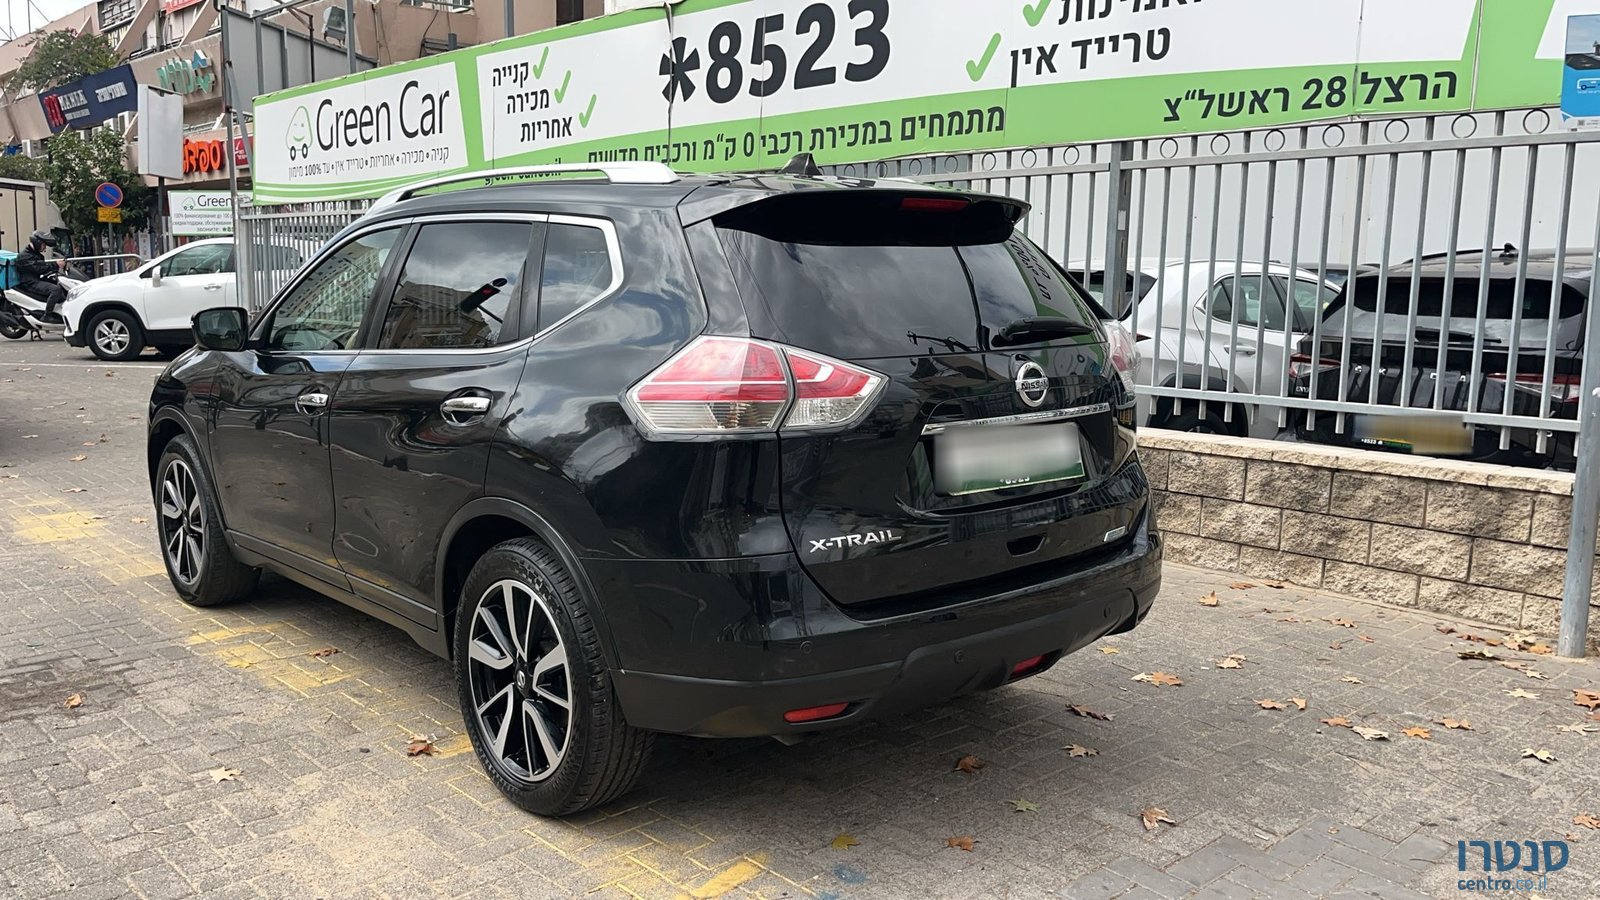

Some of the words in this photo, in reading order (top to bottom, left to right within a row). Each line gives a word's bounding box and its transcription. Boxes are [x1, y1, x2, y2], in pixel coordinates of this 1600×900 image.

[1071, 27, 1171, 70] טרייד
[492, 62, 529, 88] קנייה
[1010, 43, 1060, 88] אין
[1302, 75, 1347, 110] 28
[1360, 70, 1458, 105] הרצל
[507, 89, 550, 115] מכירה
[316, 99, 391, 151] Green
[399, 80, 450, 139] Car
[901, 106, 1005, 141] מתמחים
[520, 117, 573, 142] אחריות
[809, 120, 893, 152] במכירת
[431, 146, 449, 164] קניה
[743, 132, 755, 157] 0
[760, 130, 803, 156] רכבי
[305, 163, 321, 176] 100%
[369, 153, 395, 169] אחריות
[401, 149, 425, 165] מכירה
[809, 529, 902, 553] X-TRAIL
